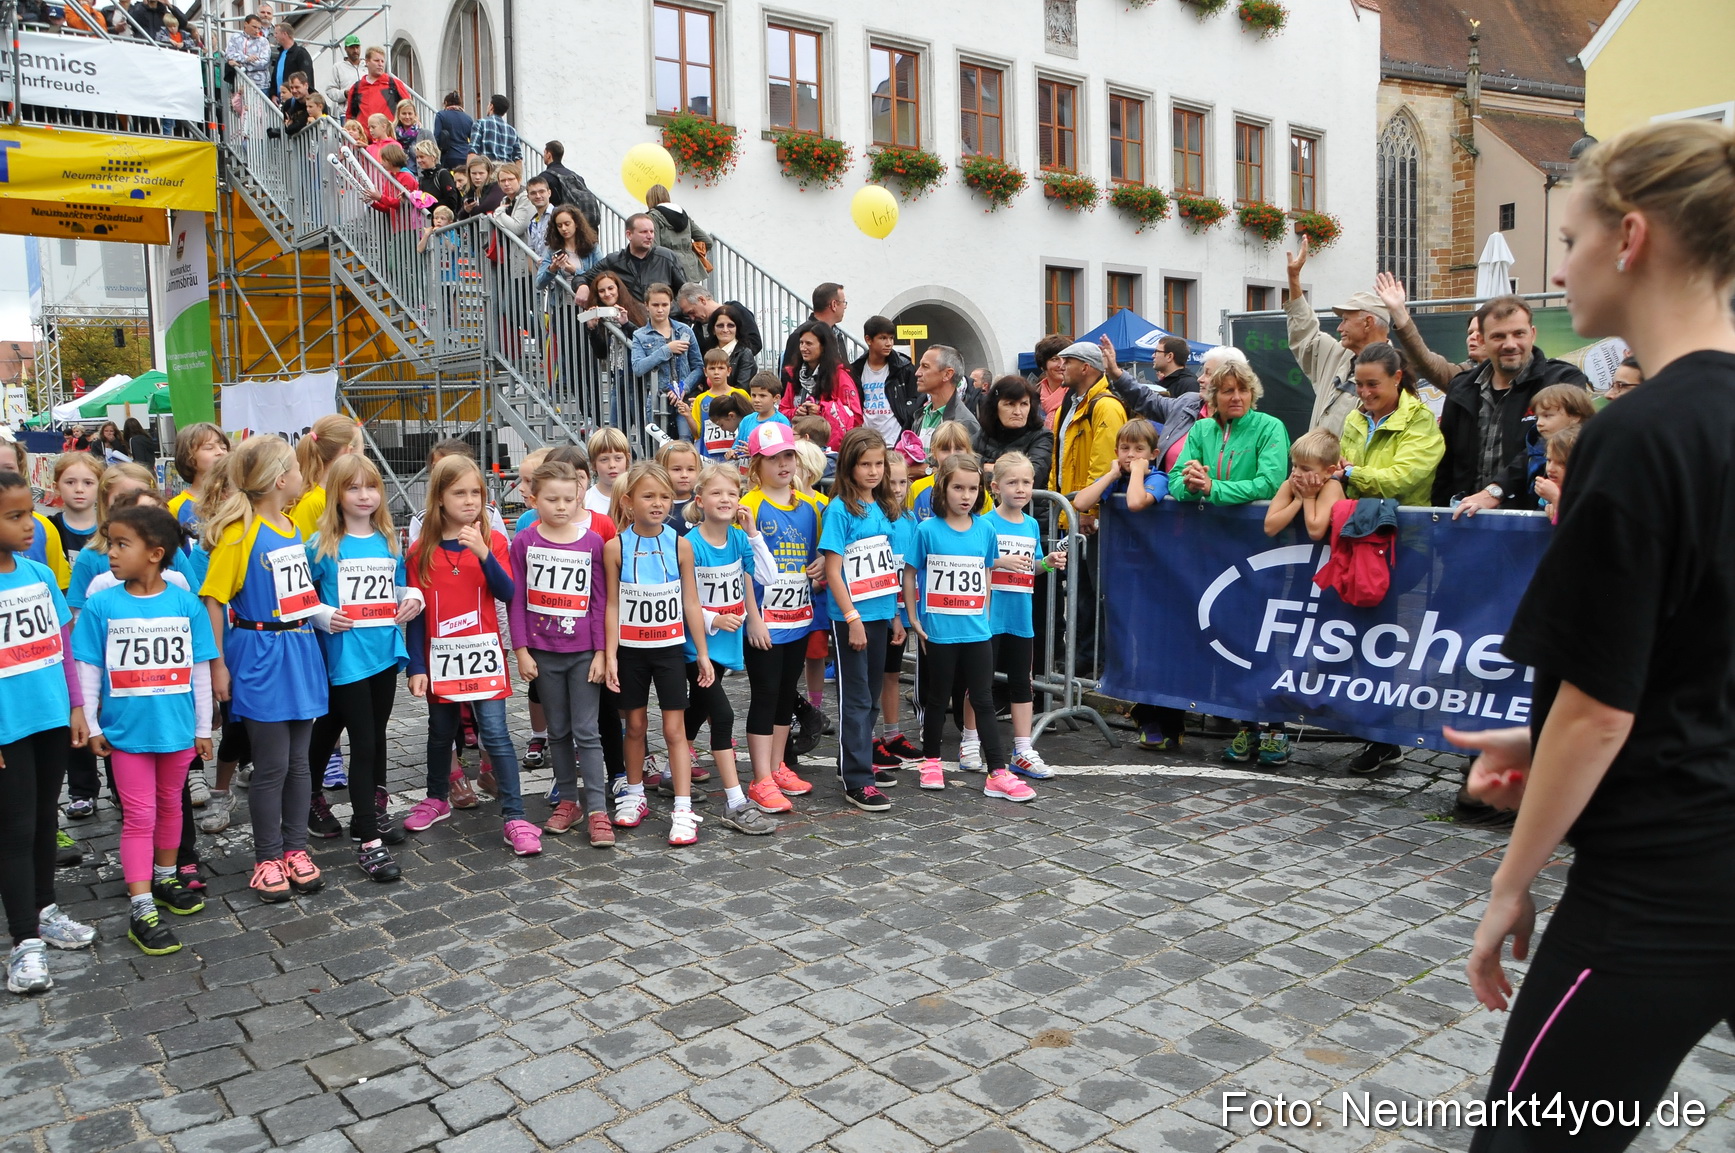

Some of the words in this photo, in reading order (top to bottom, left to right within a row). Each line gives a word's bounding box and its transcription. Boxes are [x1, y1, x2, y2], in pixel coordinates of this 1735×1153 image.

[0, 70, 100, 95] Fhrfreude.
[62, 170, 131, 184] Neumarkter
[133, 175, 185, 187] Stadtlauf
[31, 207, 95, 221] Neumarkter
[96, 212, 144, 224] Stadtlauf
[528, 552, 550, 562] PARTL
[550, 555, 584, 565] Neumarkt
[849, 549, 894, 578] 7149
[928, 559, 948, 567] PARTL
[532, 563, 587, 592] 7179
[870, 576, 891, 589] Leoni
[933, 569, 982, 592] 7139
[346, 575, 395, 600] 7221
[620, 588, 641, 597] PARTL
[643, 589, 674, 598] Neumarkt
[540, 594, 572, 608] Sophia
[943, 596, 969, 606] Selma
[361, 607, 391, 618] Carolin
[626, 597, 678, 624] 7080
[0, 602, 55, 643] 7504
[108, 626, 136, 635] PARTL
[138, 625, 179, 634] Neumarkt
[449, 618, 468, 630] DEHN
[638, 629, 668, 639] Felina
[1255, 598, 1535, 683] Fische
[116, 636, 186, 666] 7503
[455, 640, 490, 650] Neumarkt
[437, 649, 498, 677] 7123
[458, 682, 479, 692] Lisa
[1270, 669, 1533, 722] AUTOMOBILE
